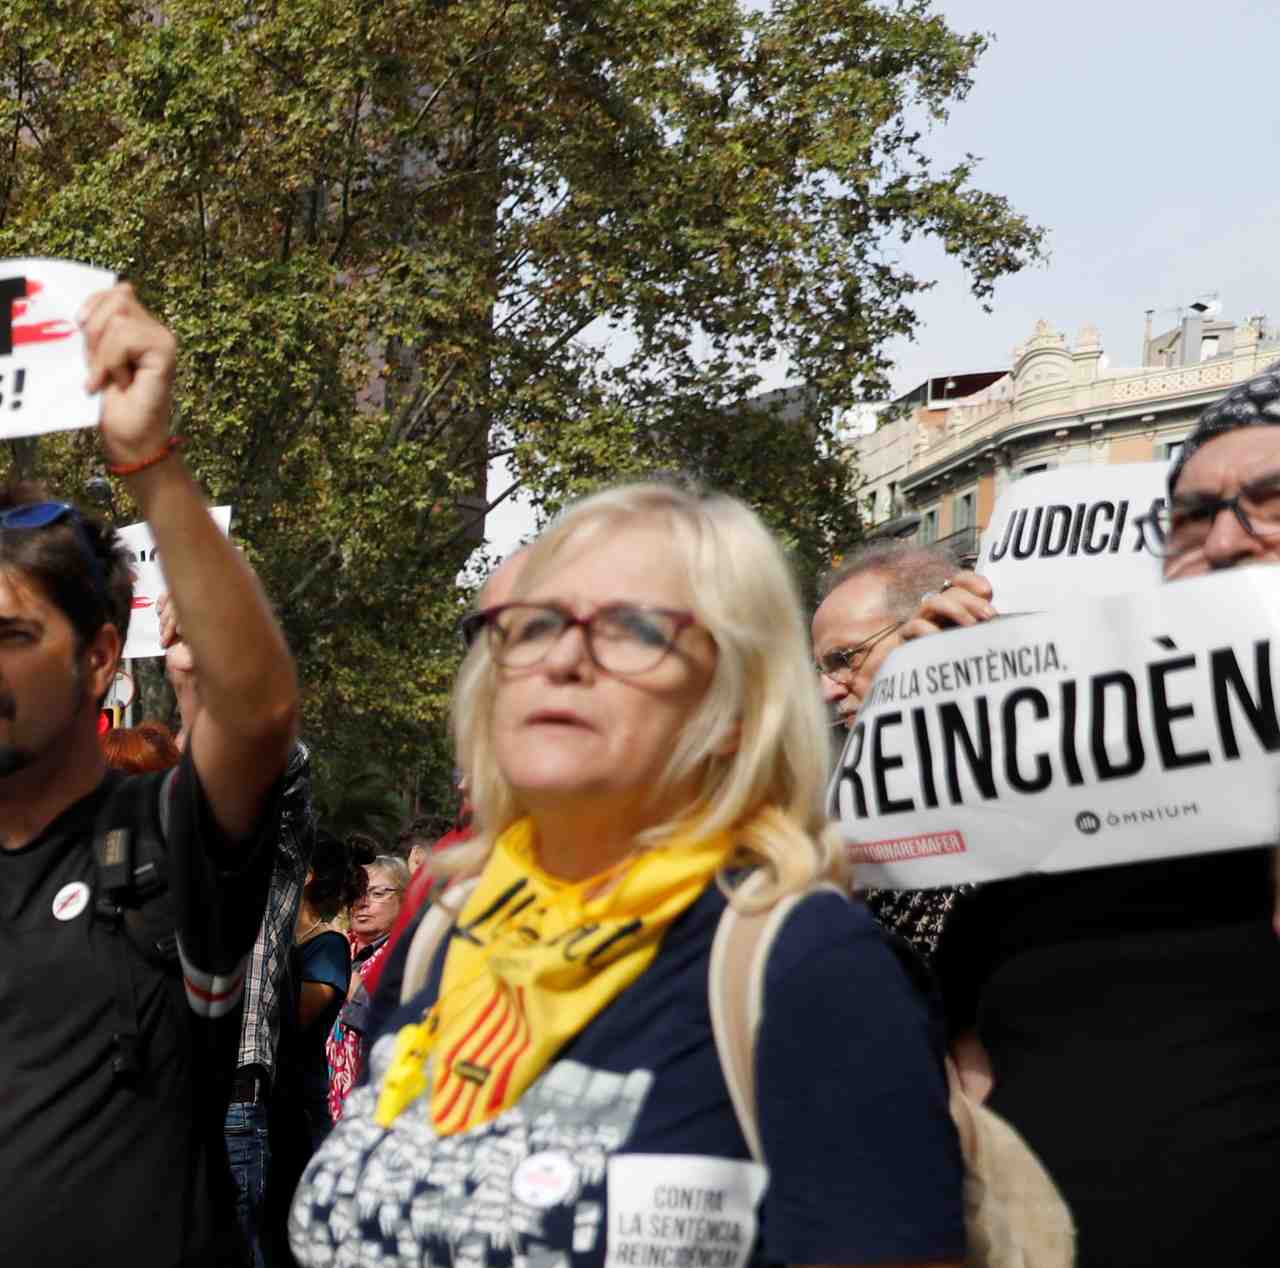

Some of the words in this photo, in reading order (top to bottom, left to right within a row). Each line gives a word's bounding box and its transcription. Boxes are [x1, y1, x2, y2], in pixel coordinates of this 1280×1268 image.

[991, 499, 1129, 562] JUDICI
[898, 668, 921, 700] LA
[1106, 801, 1201, 828] ÒMNIUM
